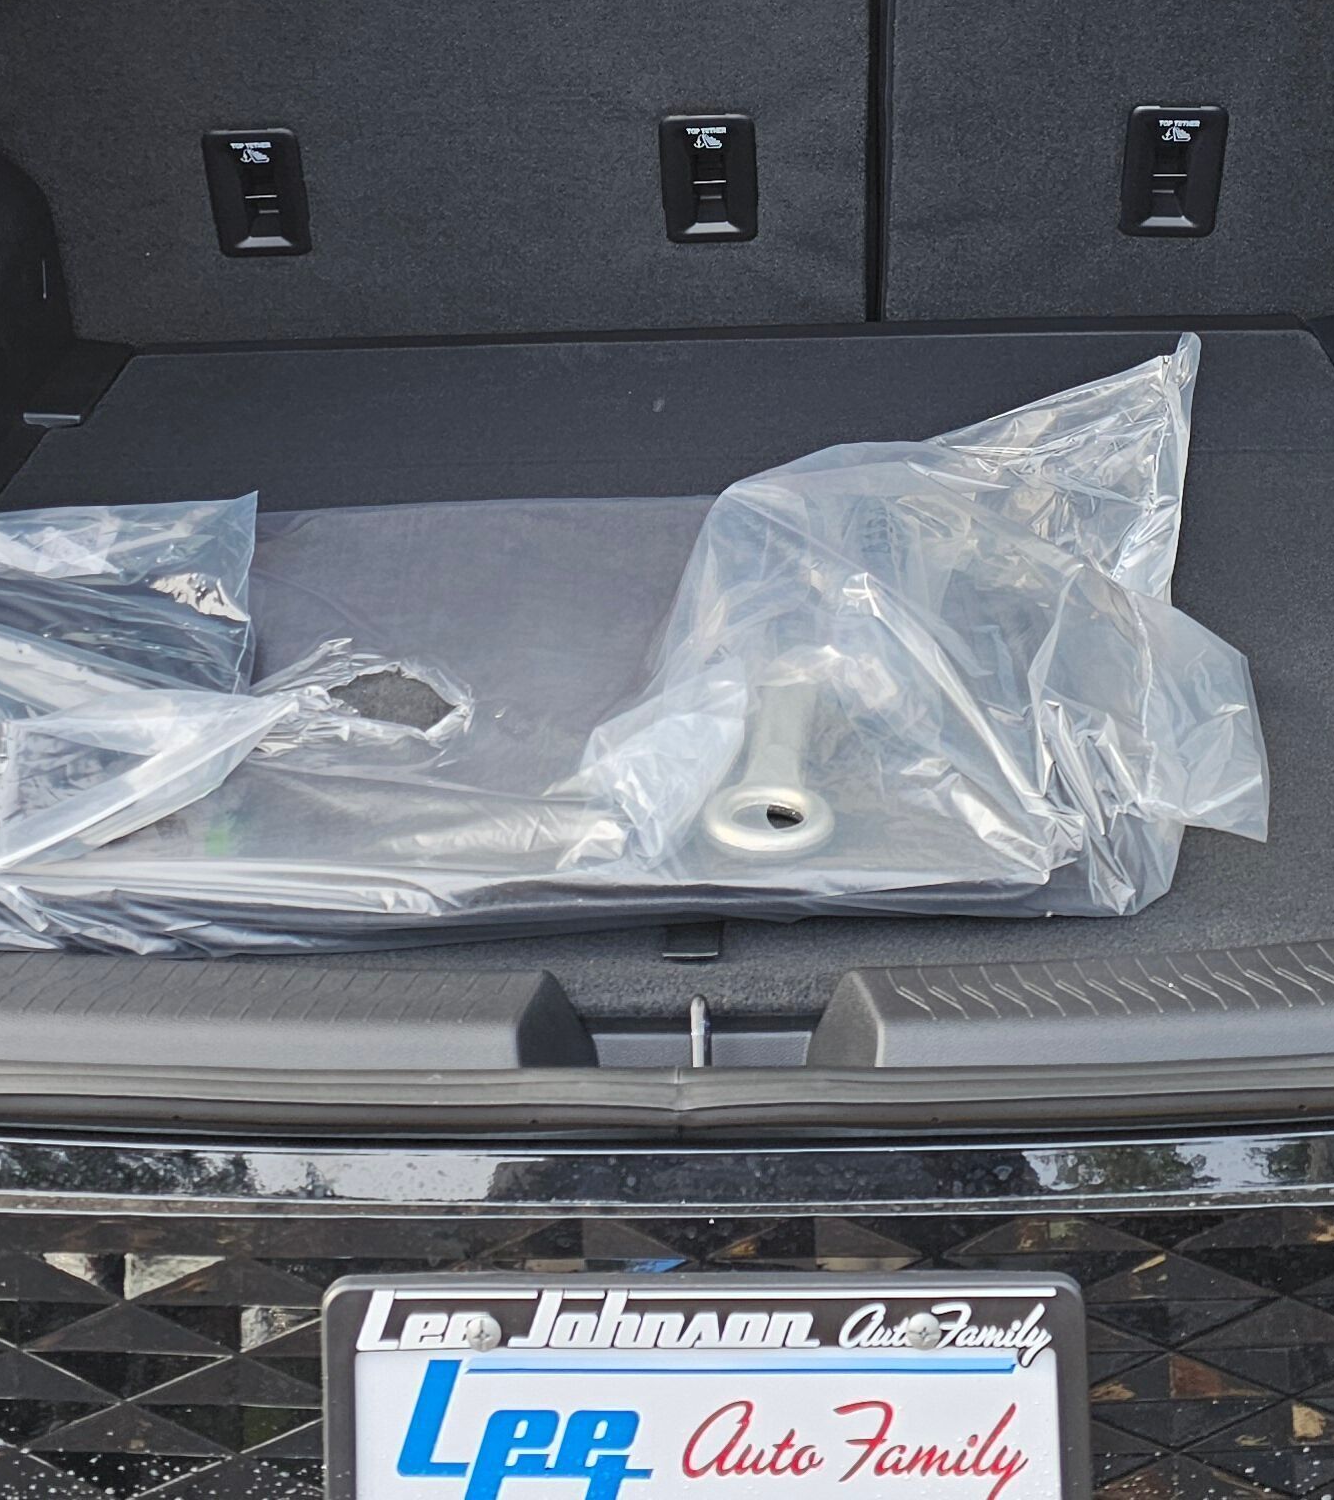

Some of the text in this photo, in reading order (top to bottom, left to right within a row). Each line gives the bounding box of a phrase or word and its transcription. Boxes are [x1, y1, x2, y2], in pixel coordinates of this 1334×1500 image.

[506, 1289, 821, 1349] Johnson
[838, 1302, 915, 1349] Aut
[930, 1301, 1053, 1368] Family
[396, 1359, 654, 1479] Lee
[681, 1400, 1029, 1500] Auto Family
